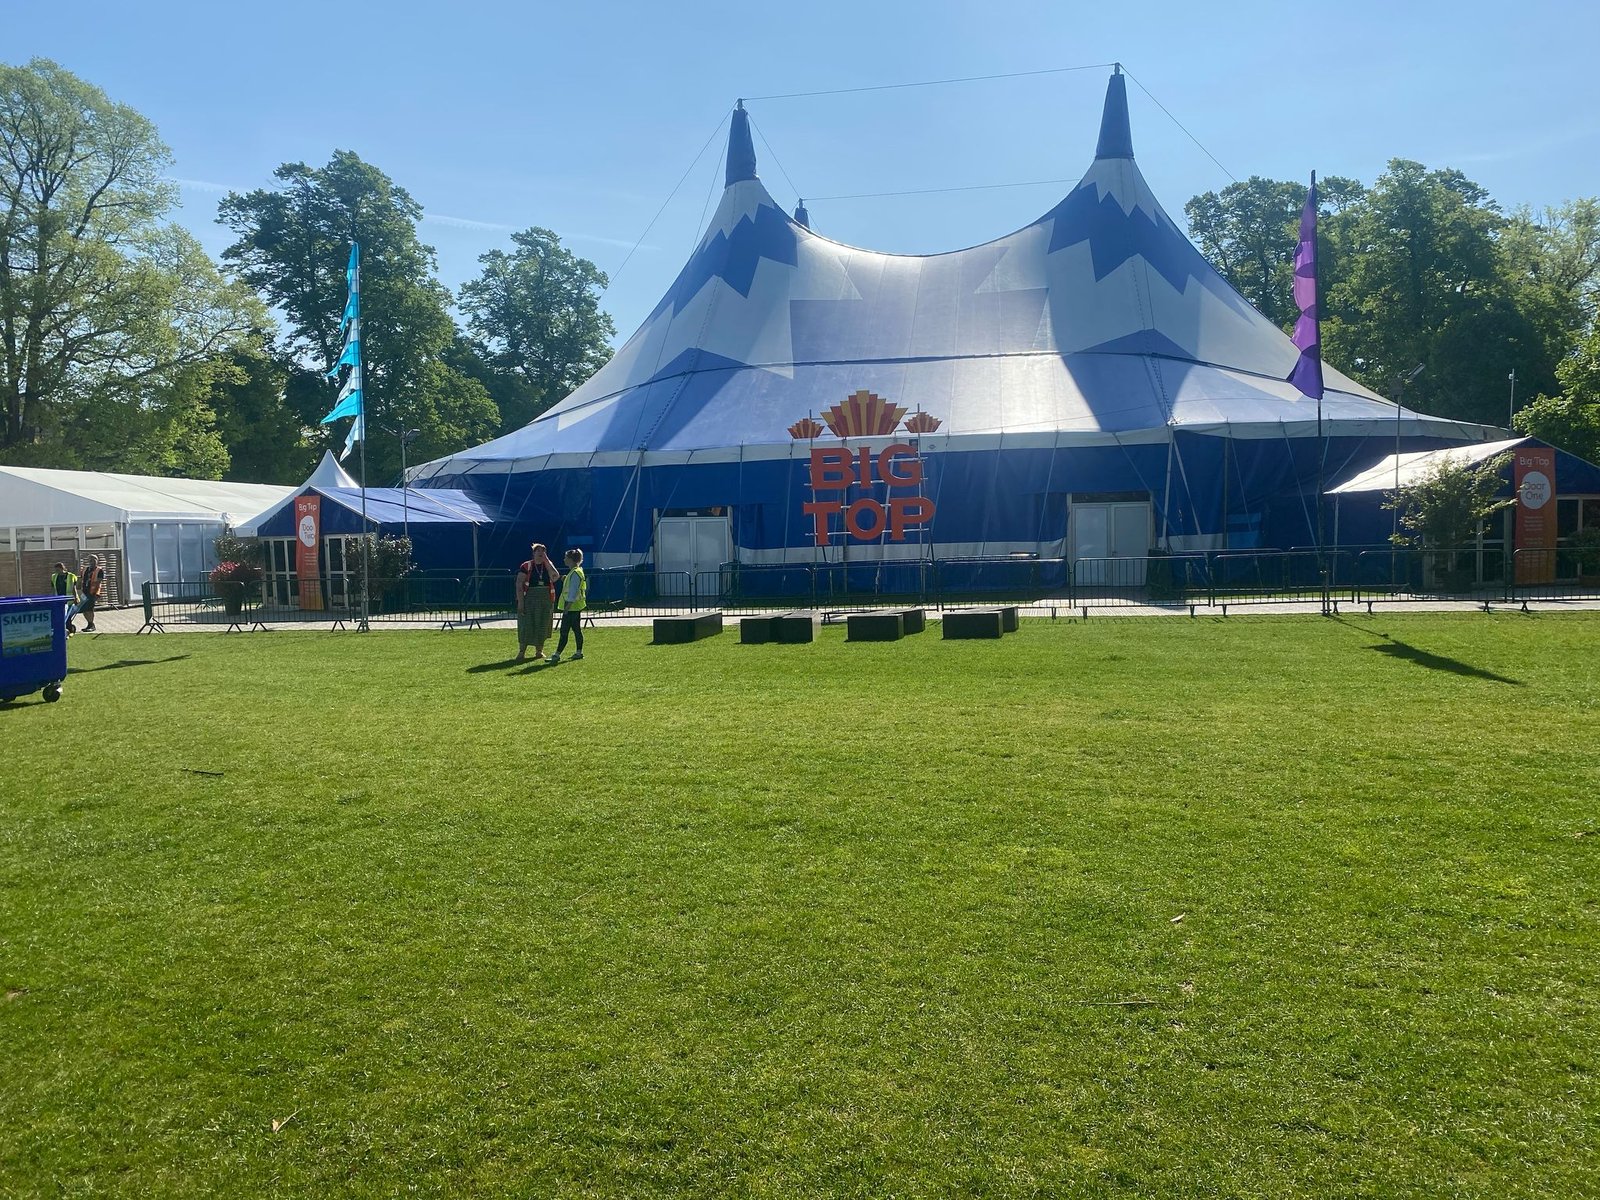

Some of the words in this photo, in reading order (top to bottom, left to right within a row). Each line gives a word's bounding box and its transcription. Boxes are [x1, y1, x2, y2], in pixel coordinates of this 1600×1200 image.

[810, 444, 921, 489] BIG
[803, 497, 936, 545] TOP
[3, 612, 49, 625] SMITHS
